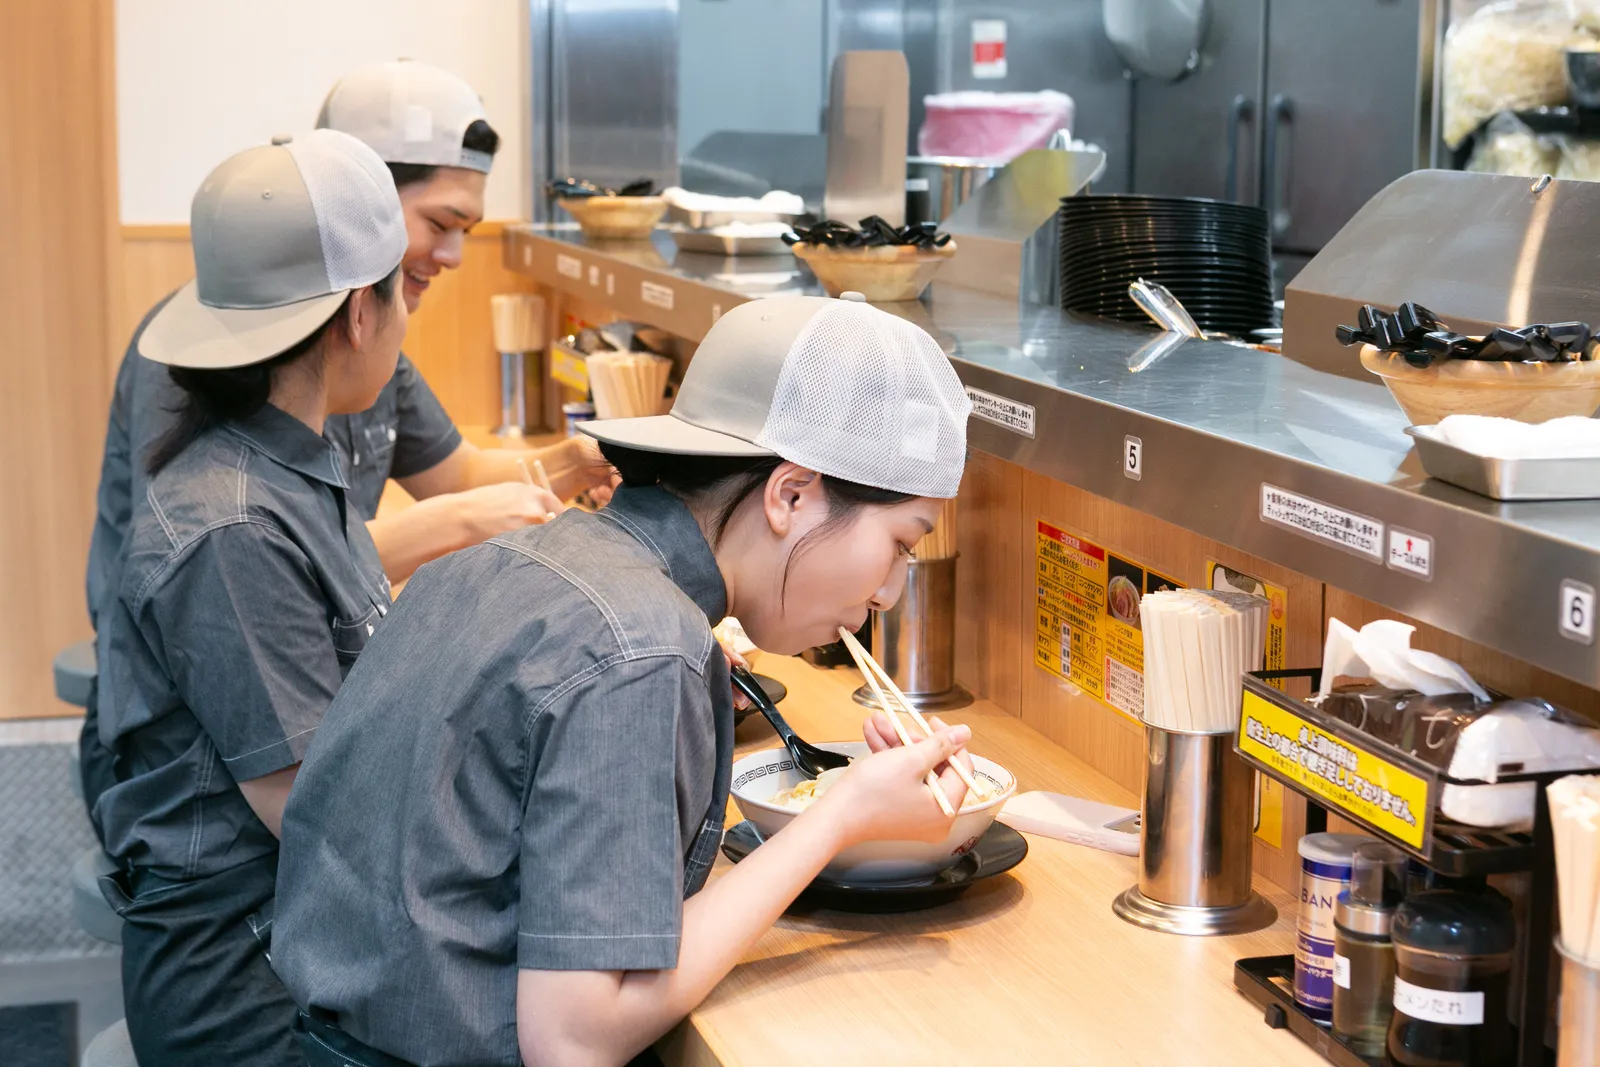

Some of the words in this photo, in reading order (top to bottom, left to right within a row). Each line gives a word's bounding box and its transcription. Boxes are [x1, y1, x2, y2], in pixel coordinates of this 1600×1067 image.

[1128, 445, 1137, 469] 5
[1571, 596, 1584, 627] 6
[1298, 724, 1359, 773] 卓上調味料は
[1246, 716, 1417, 827] 衛生上の都合で継ぎ足ししておりません。
[1301, 887, 1333, 910] BAN
[1394, 990, 1464, 1016] ーメンたれ
